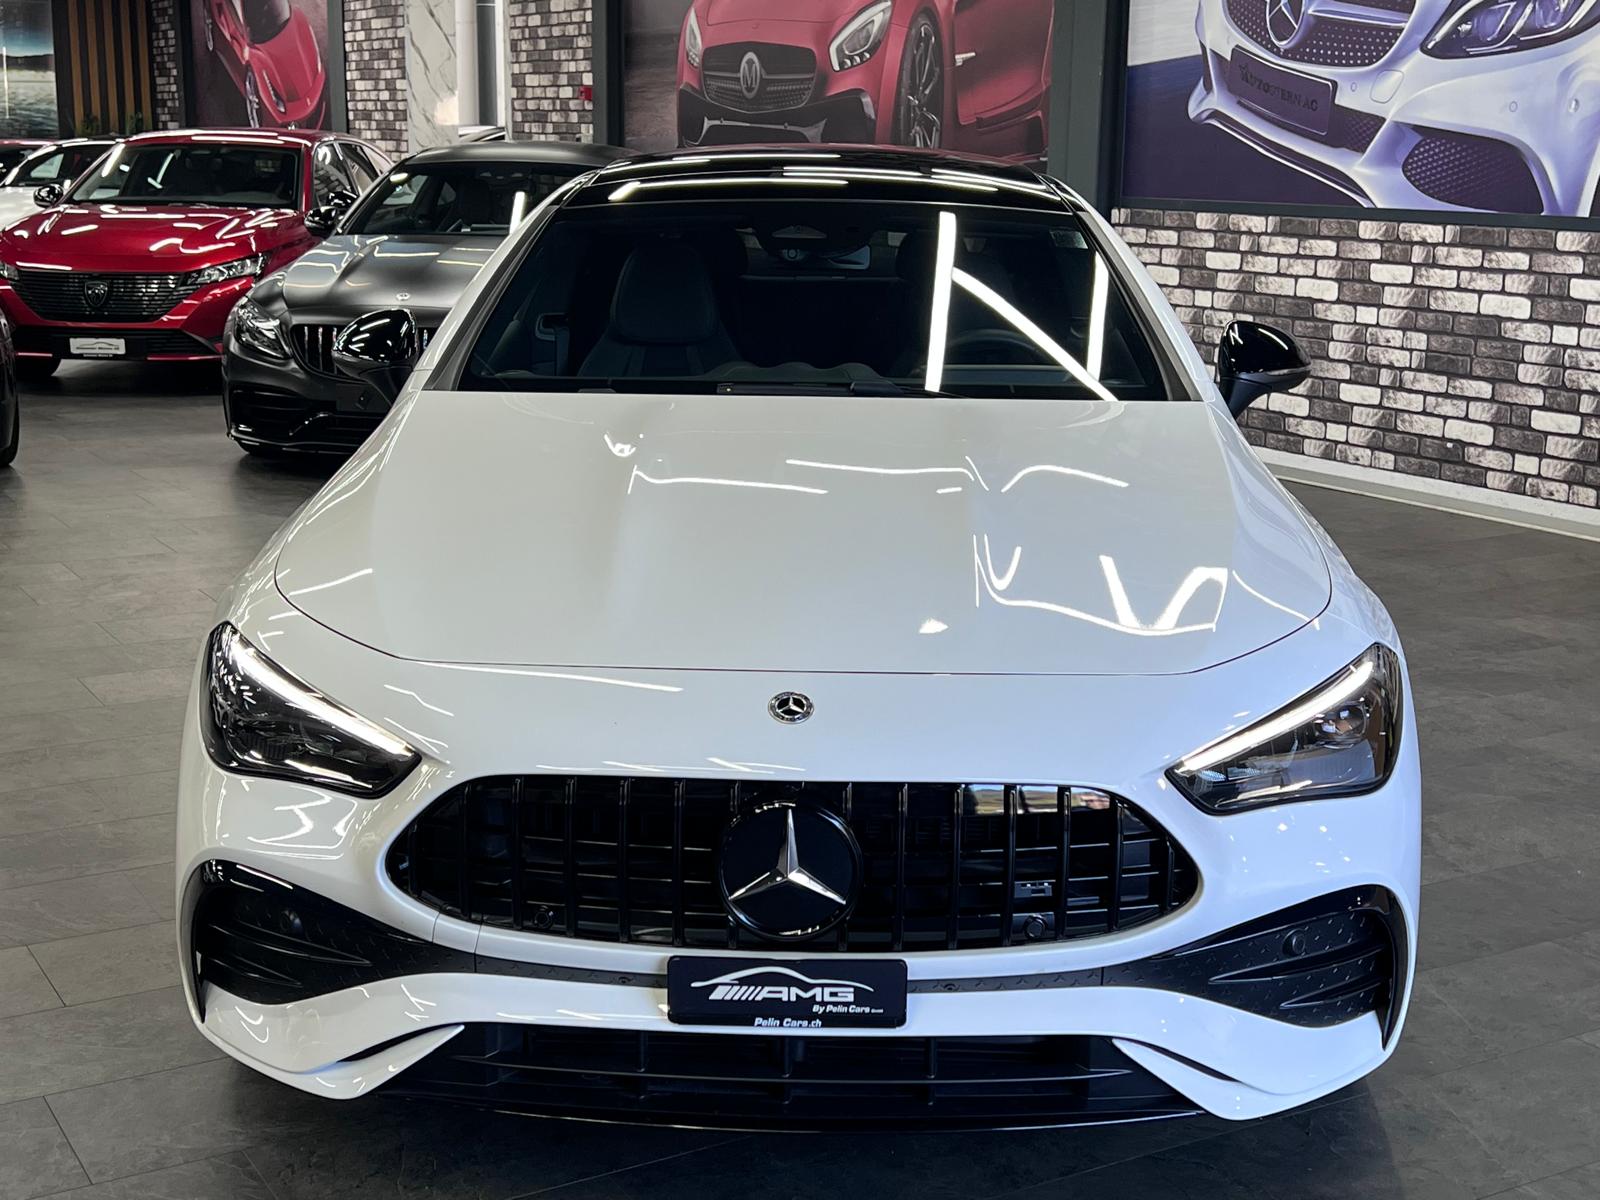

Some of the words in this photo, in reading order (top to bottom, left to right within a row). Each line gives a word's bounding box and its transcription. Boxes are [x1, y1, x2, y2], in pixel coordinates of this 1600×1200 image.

[757, 985, 855, 1002] AMG
[812, 1004, 825, 1014] By
[826, 1004, 848, 1013] Pelin
[849, 1005, 870, 1013] Cars
[754, 1017, 780, 1027] Pelin
[783, 1018, 822, 1027] Cars.ch
